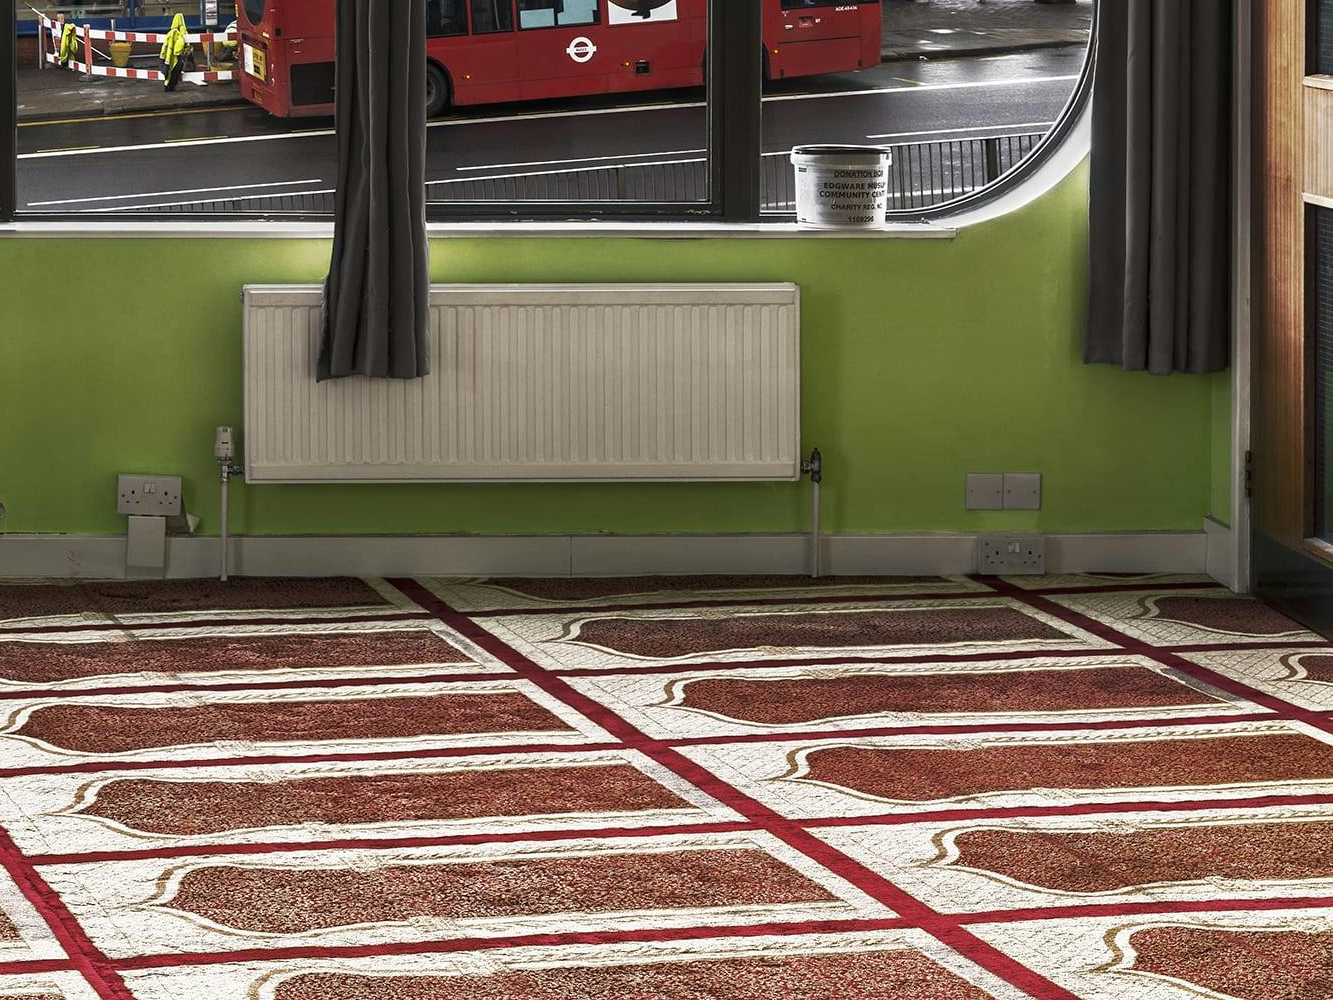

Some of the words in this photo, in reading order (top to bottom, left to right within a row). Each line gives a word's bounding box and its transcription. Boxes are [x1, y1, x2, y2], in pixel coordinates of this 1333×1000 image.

[834, 169, 873, 178] DONATION
[823, 182, 865, 190] EDGWARE
[819, 190, 870, 198] COMMUNITY
